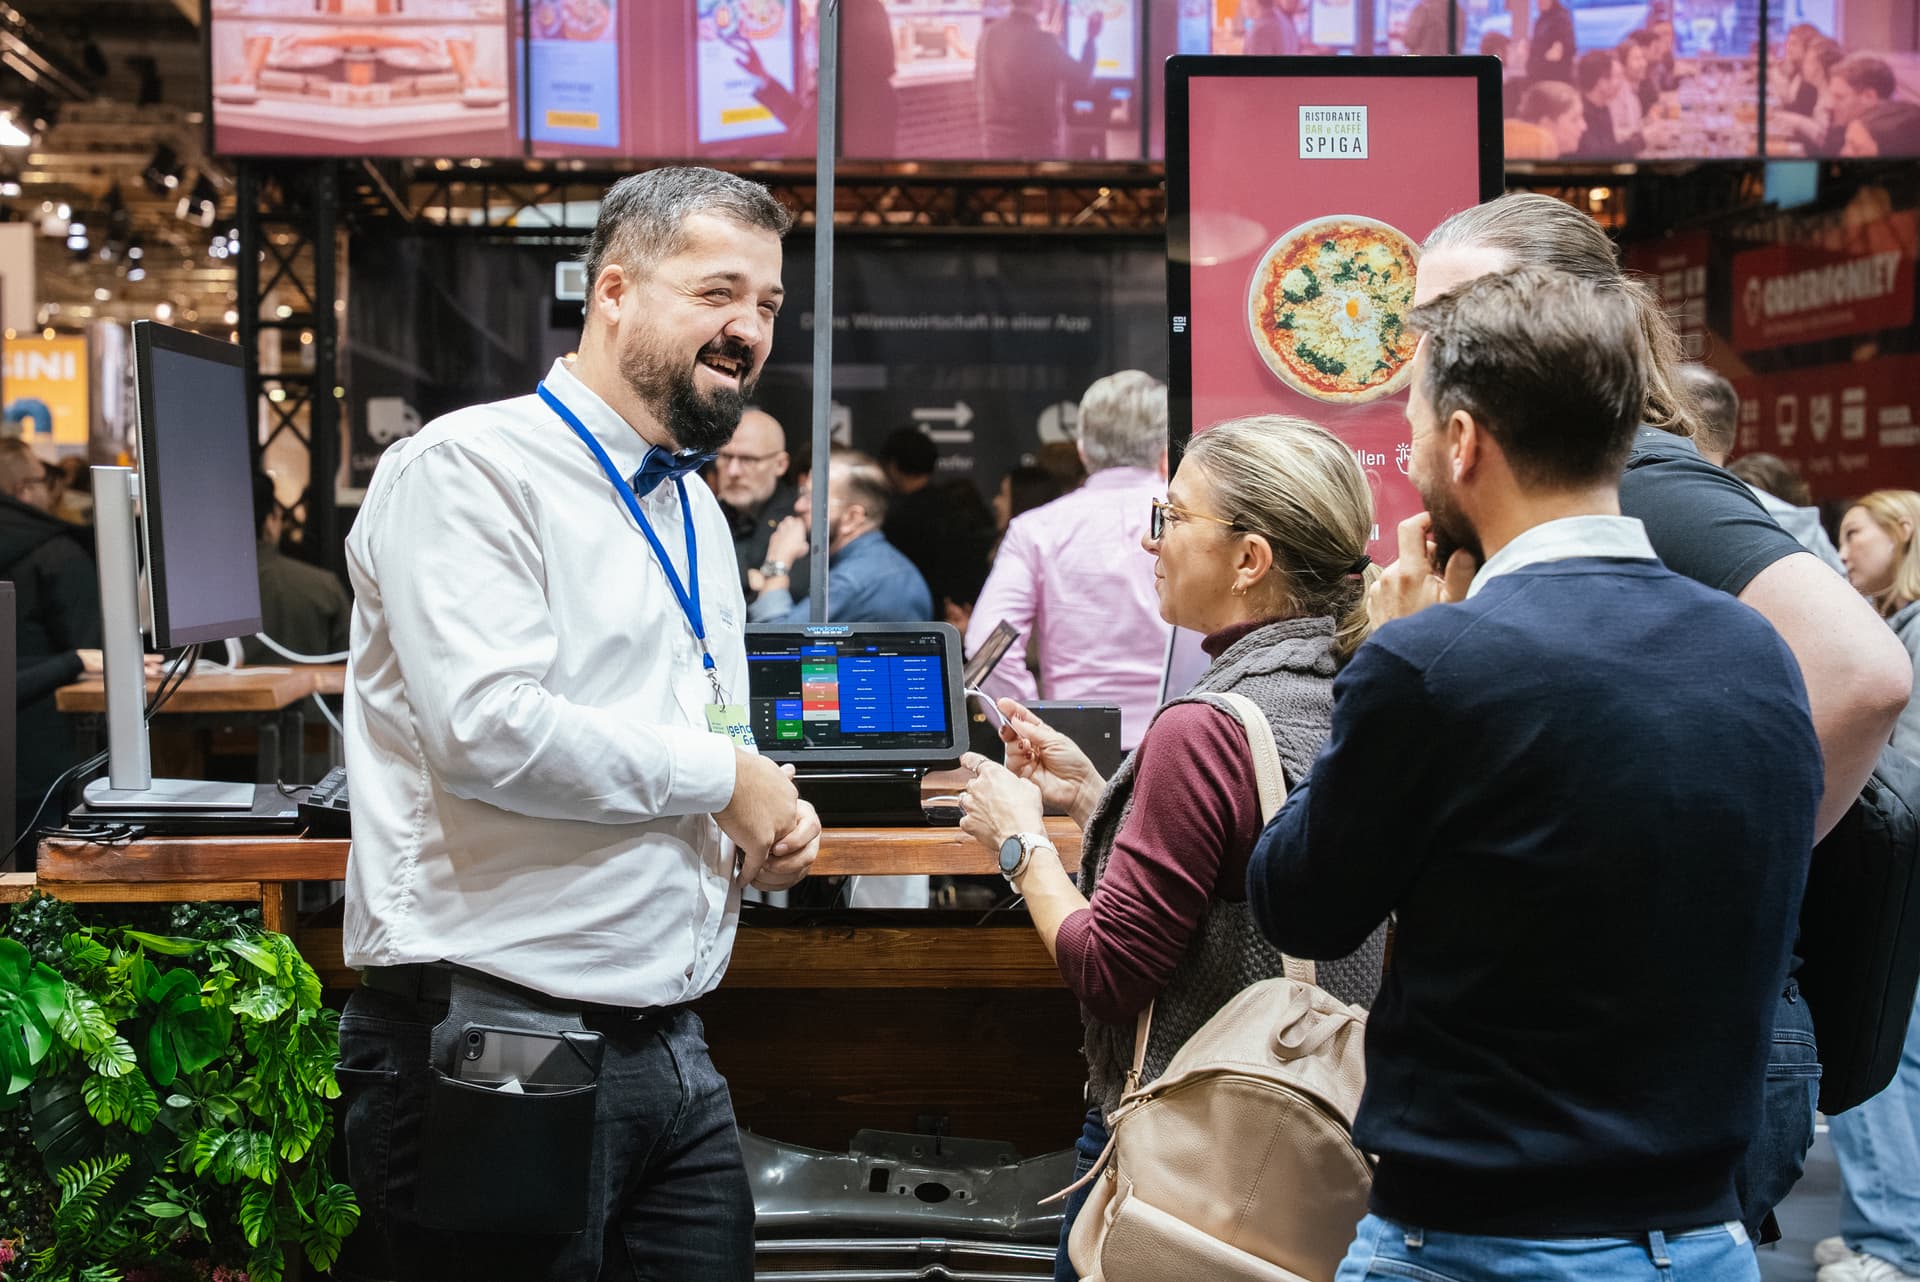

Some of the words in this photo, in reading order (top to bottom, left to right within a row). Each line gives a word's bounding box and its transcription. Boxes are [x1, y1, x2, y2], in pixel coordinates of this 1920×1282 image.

[1305, 111, 1361, 121] RISTORANTE
[1305, 124, 1323, 134] BAR
[1305, 136, 1362, 153] SPIGA
